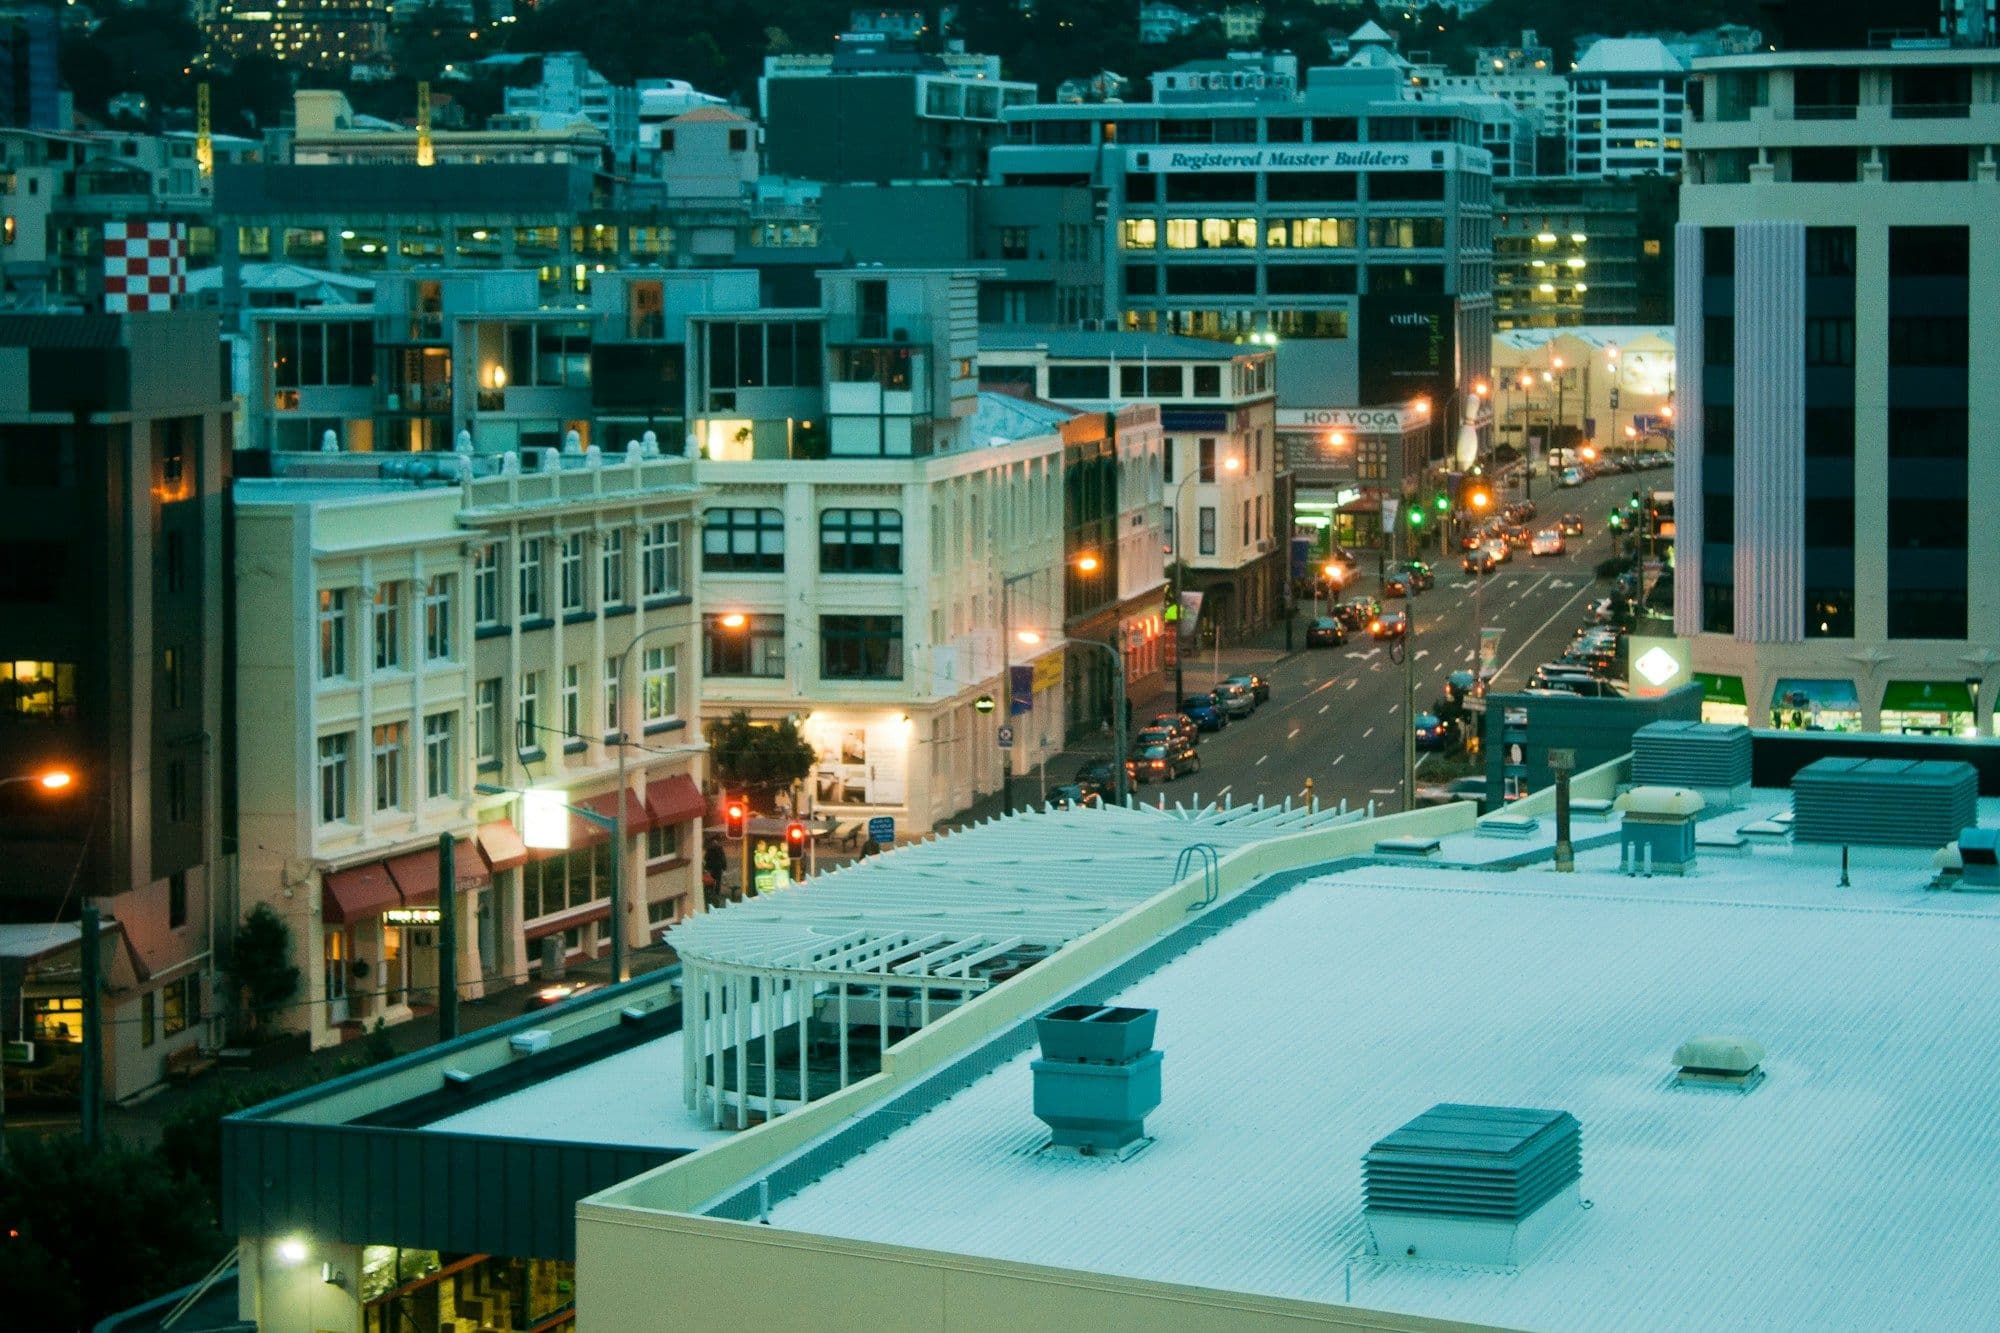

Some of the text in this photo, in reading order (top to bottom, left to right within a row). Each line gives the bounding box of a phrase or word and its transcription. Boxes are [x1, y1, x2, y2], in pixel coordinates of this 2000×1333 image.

[1171, 151, 1409, 170] Registered Master Builders
[1304, 412, 1399, 424] HOT YOGA
